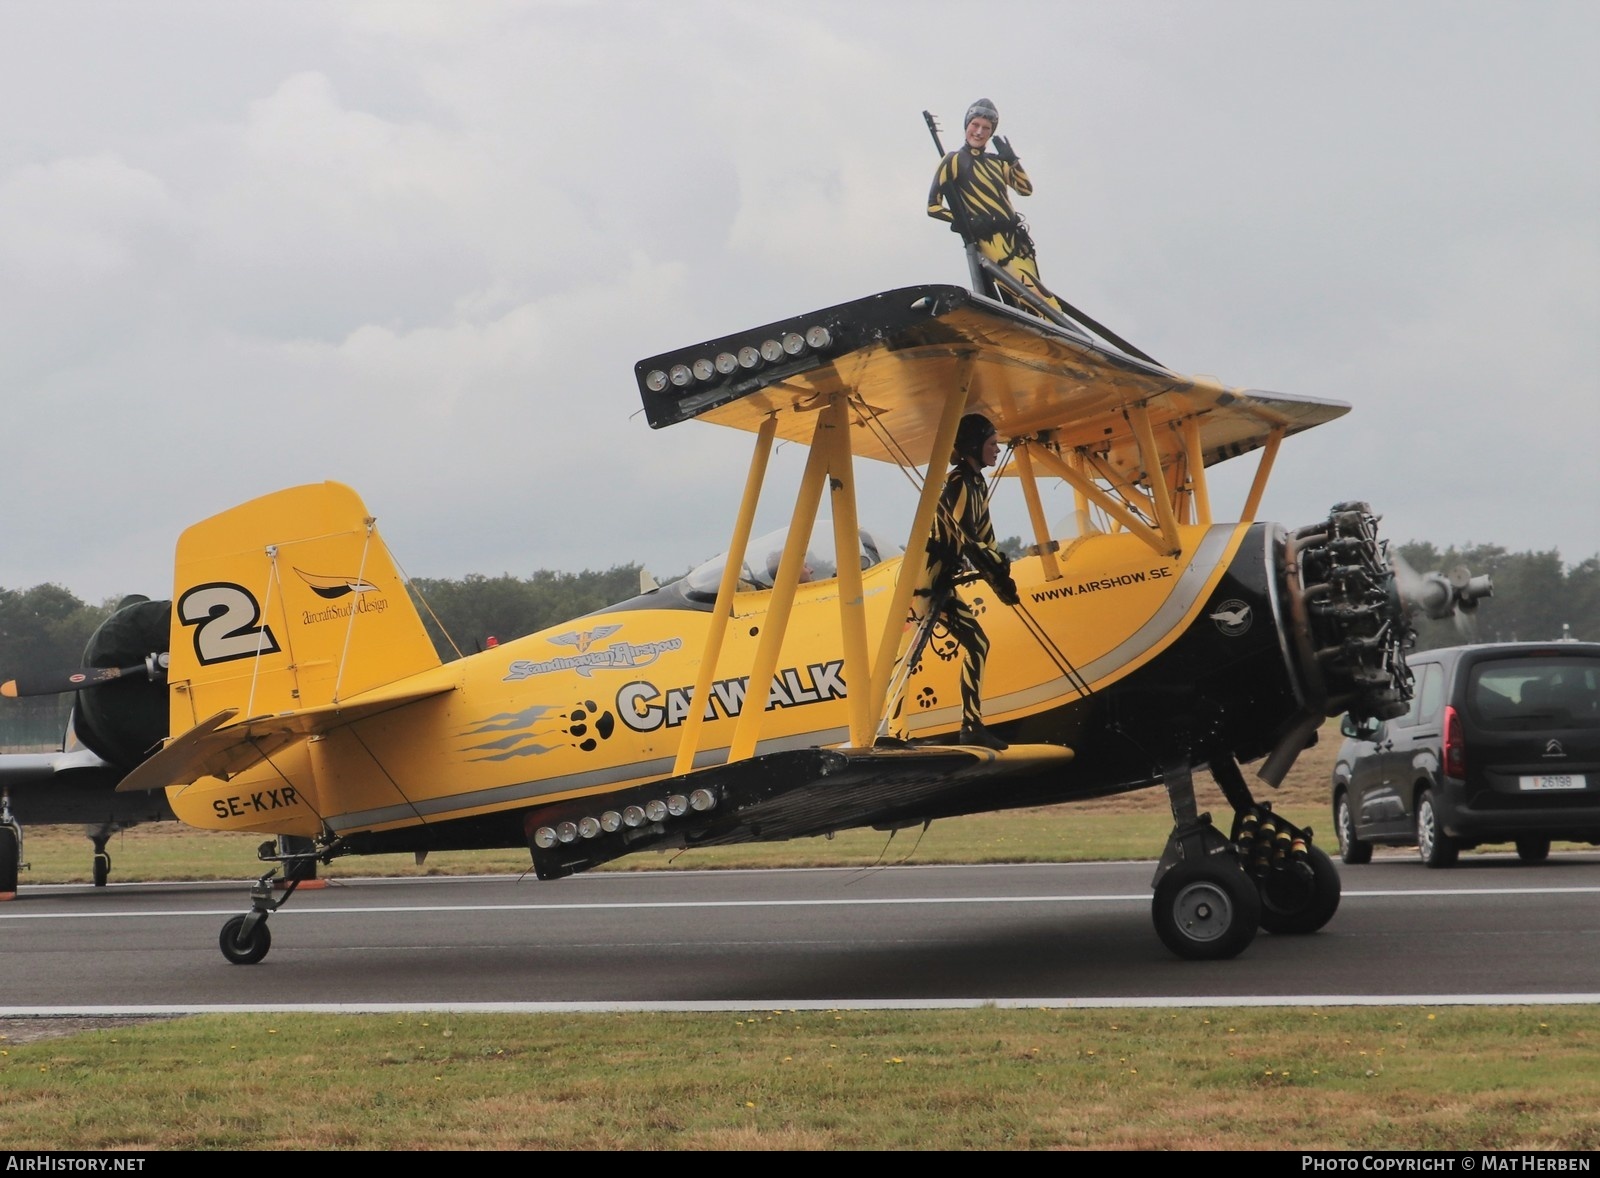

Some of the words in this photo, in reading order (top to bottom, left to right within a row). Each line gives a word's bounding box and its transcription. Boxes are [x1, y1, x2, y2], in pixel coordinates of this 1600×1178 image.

[1031, 566, 1173, 603] WWW.AIRSHOW.SE
[177, 582, 281, 666] 2
[502, 651, 616, 681] Scandinavian
[609, 638, 682, 666] Airshow
[1541, 776, 1572, 788] 26198
[213, 786, 299, 819] SE-KXR
